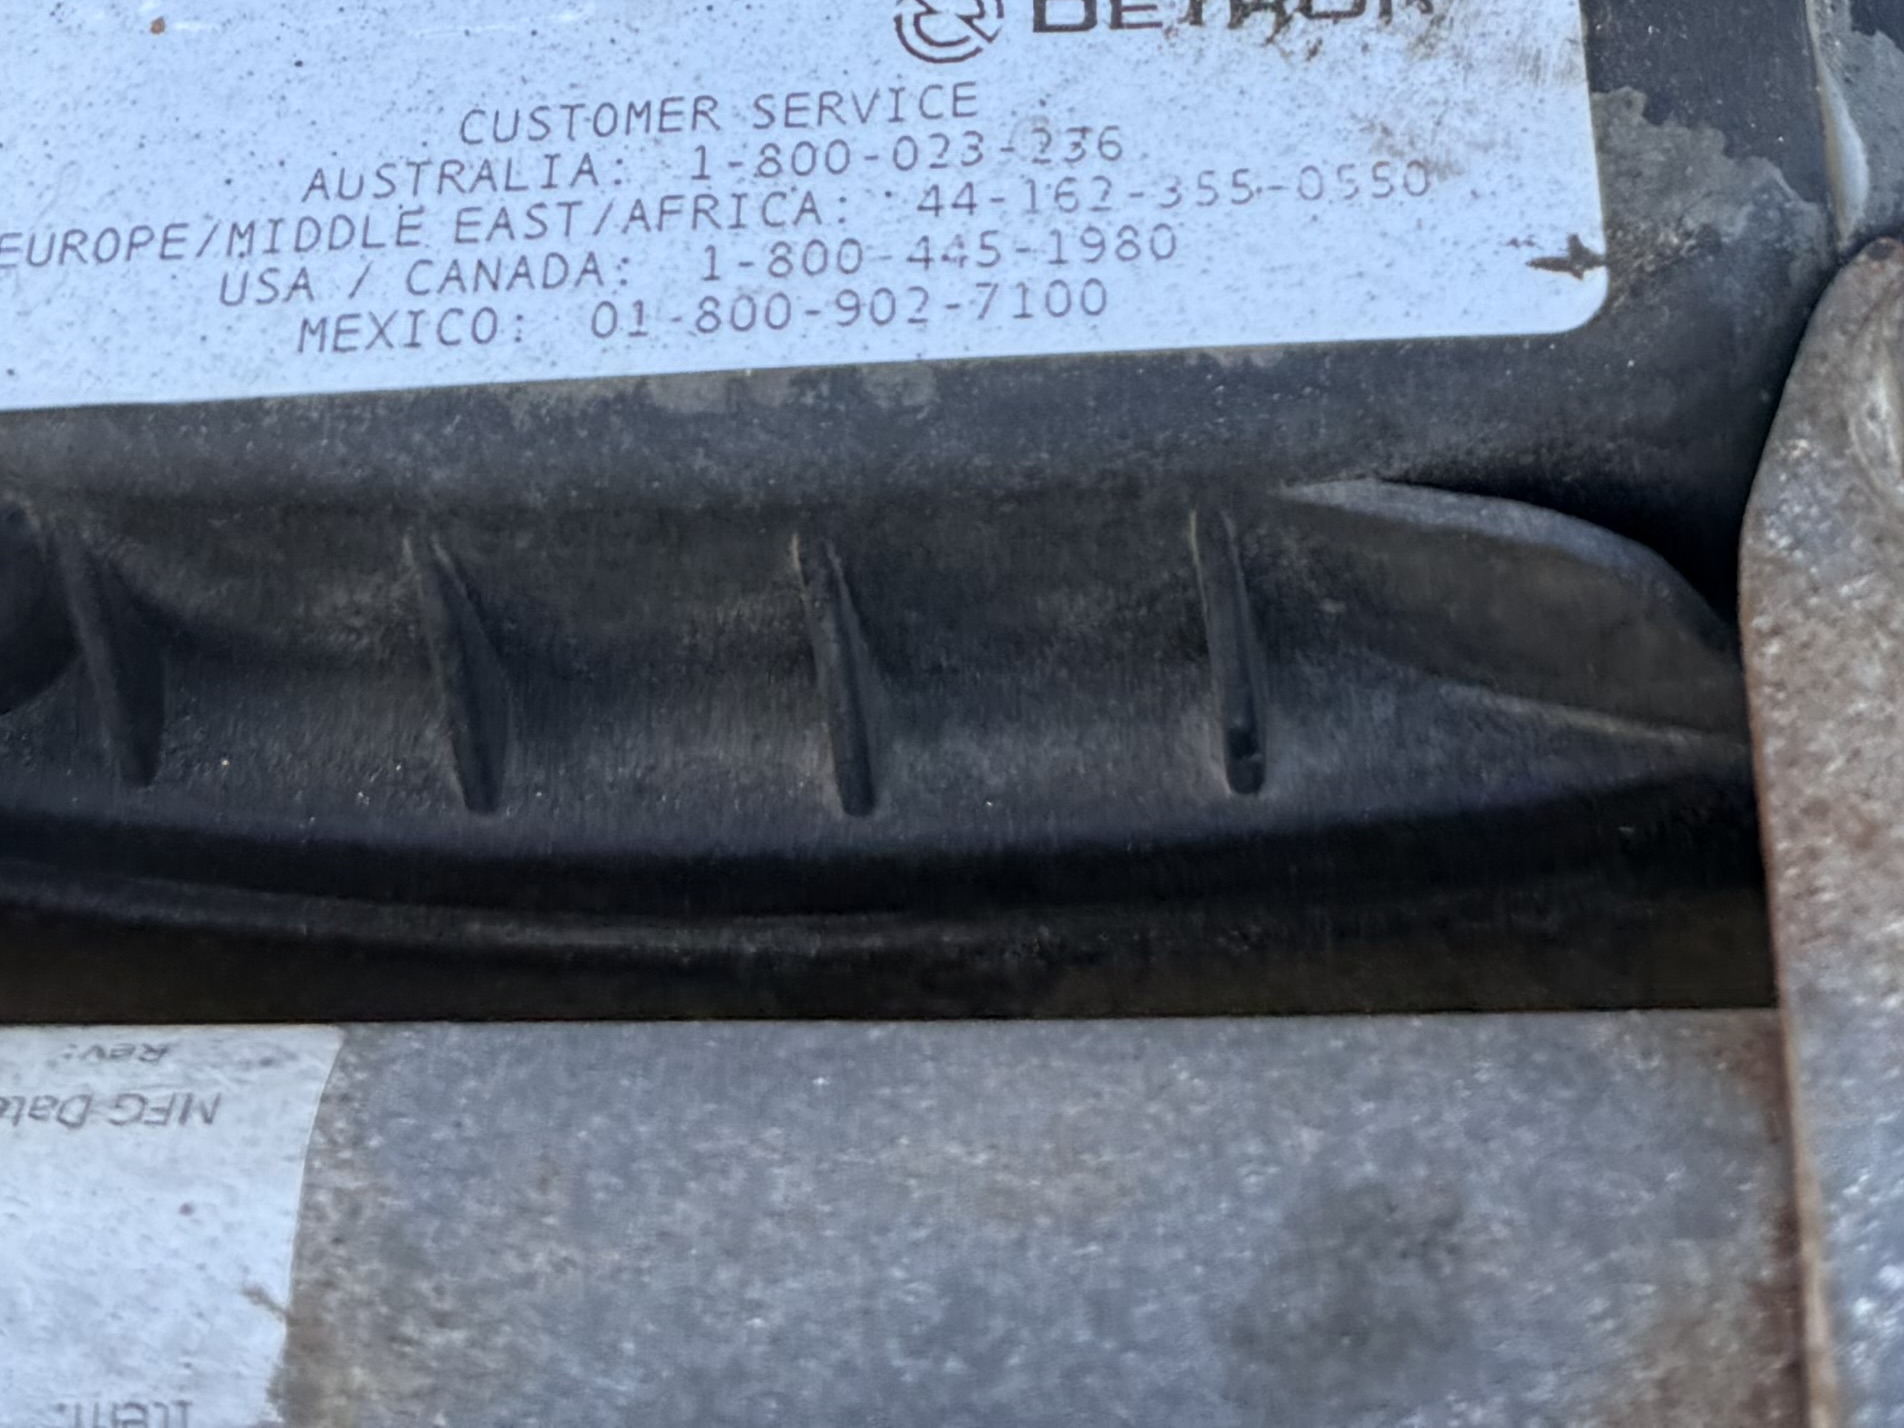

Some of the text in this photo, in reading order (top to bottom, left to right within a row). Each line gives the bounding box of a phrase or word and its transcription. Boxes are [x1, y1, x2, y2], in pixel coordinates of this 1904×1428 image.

[457, 81, 979, 145] CUSTOMER SERVICE
[301, 150, 628, 202] AUSTRALIA:
[454, 187, 849, 244] EAST/AFRICA:
[218, 222, 1177, 306] USA / CANADA: 1-800-445-1980
[296, 275, 1107, 355] MEXICO: 01-800-902-7100
[107, 1093, 223, 1128] MFG
